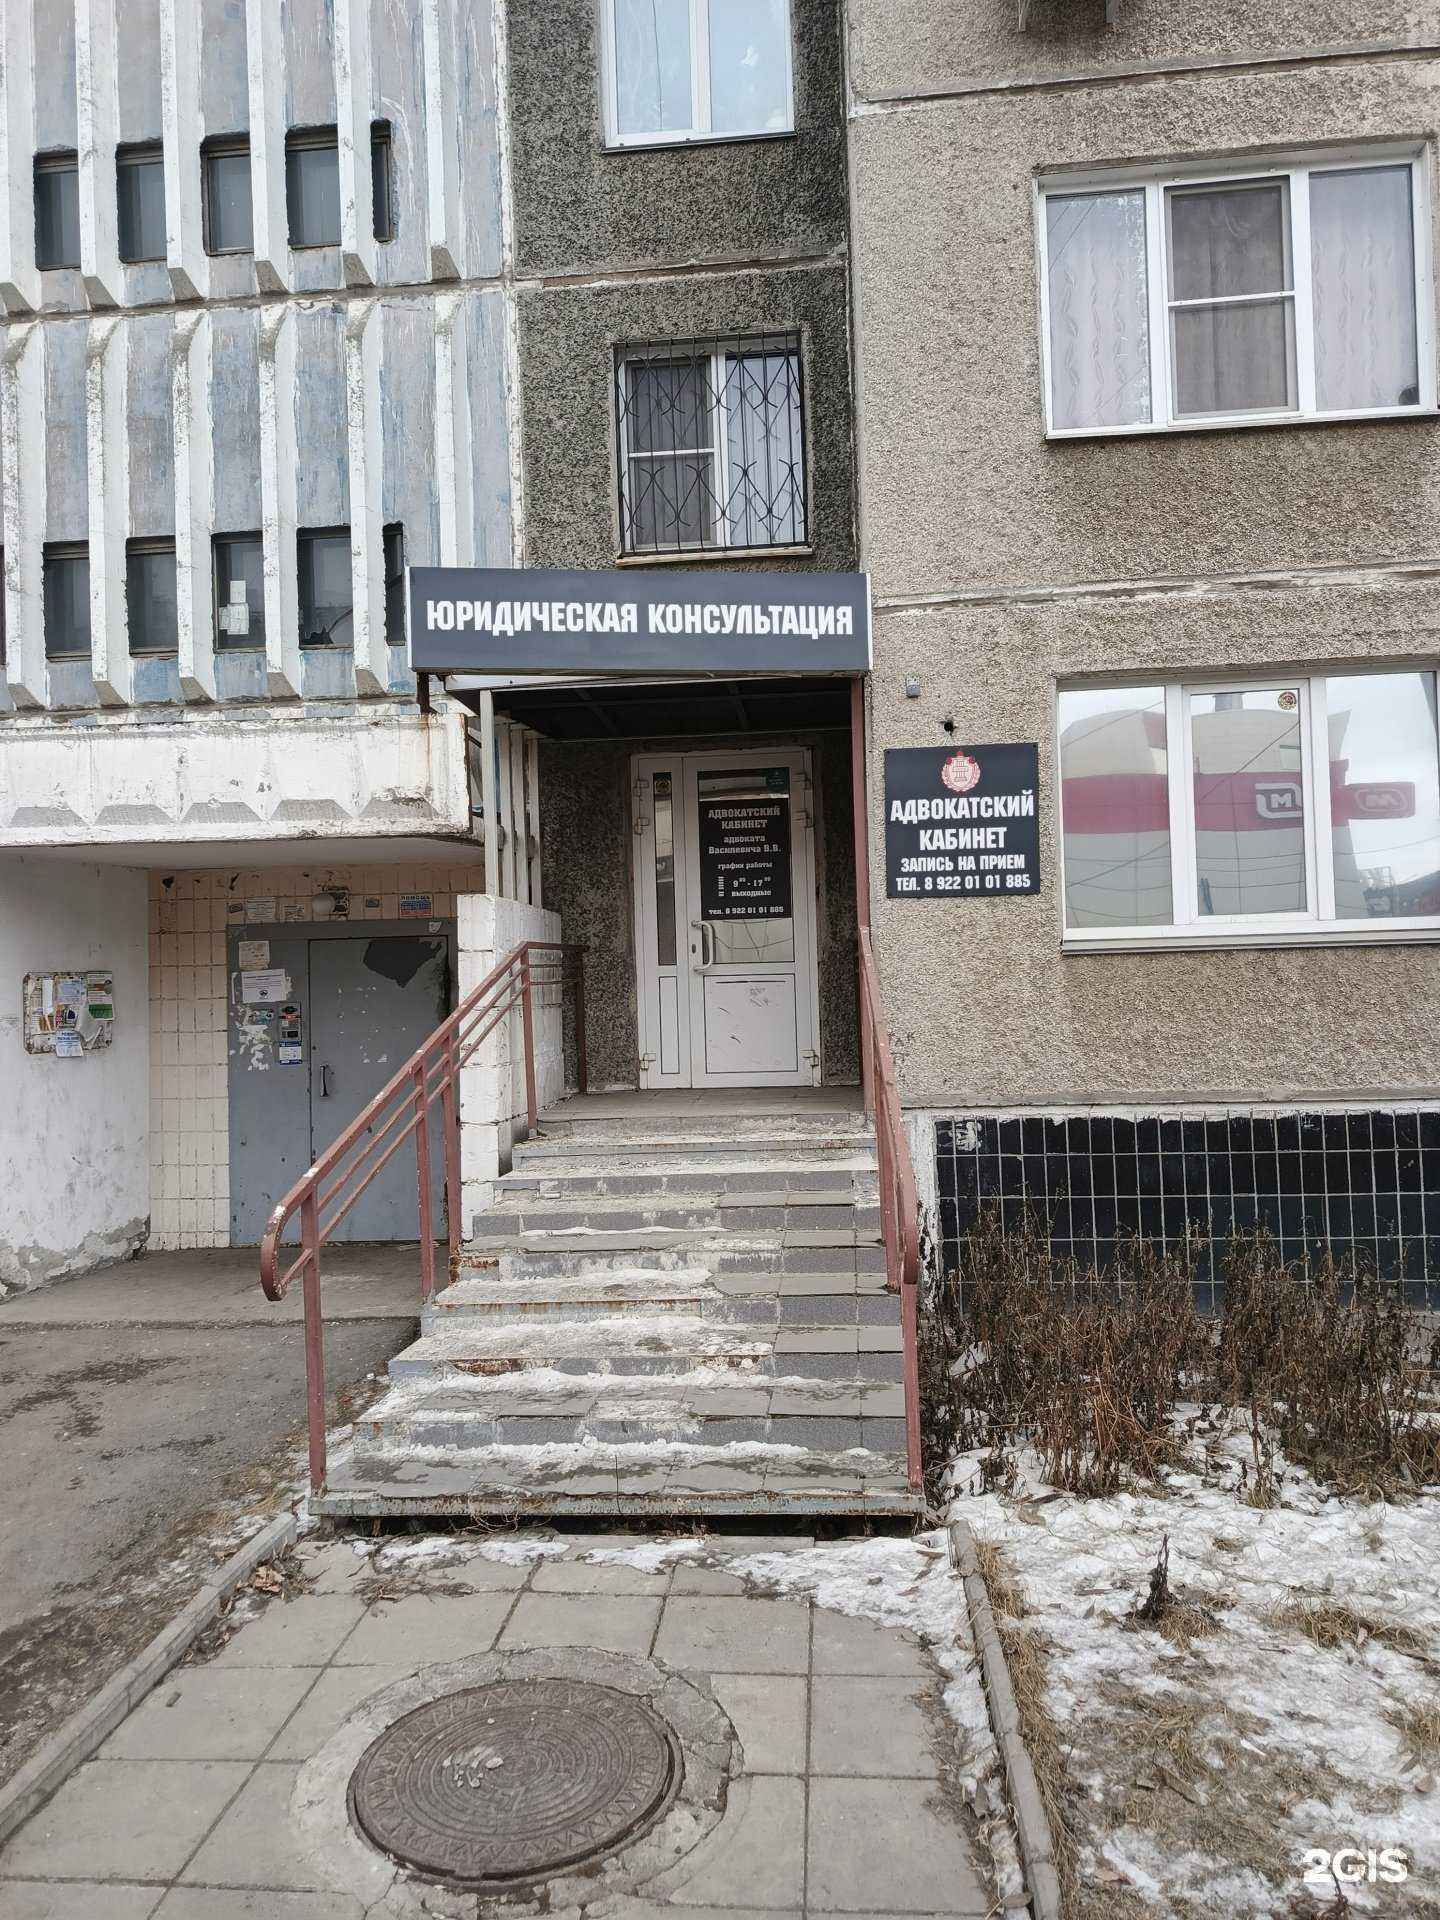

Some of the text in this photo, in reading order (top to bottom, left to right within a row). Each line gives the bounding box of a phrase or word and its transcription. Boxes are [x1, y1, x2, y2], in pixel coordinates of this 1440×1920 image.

[427, 600, 854, 640] ЮРИДИЧЕСКАЯ КОНСУЛЬТАЦИЯ
[708, 805, 781, 819] АДВОКАТСКИЙ
[890, 789, 1034, 824] АДВОКАТСКИЙ
[721, 819, 768, 829] КАБИНЕТ
[723, 835, 766, 843] адвоката
[919, 827, 1007, 851] КАБИНЕТ
[763, 844, 782, 853] В.В.
[746, 862, 773, 870] работы
[900, 854, 1026, 872] ЗАПИСЬ НА ПРИЕМ
[896, 874, 1031, 891] ТЕЛ. 8 922 01 01 885
[731, 890, 772, 898] выходные
